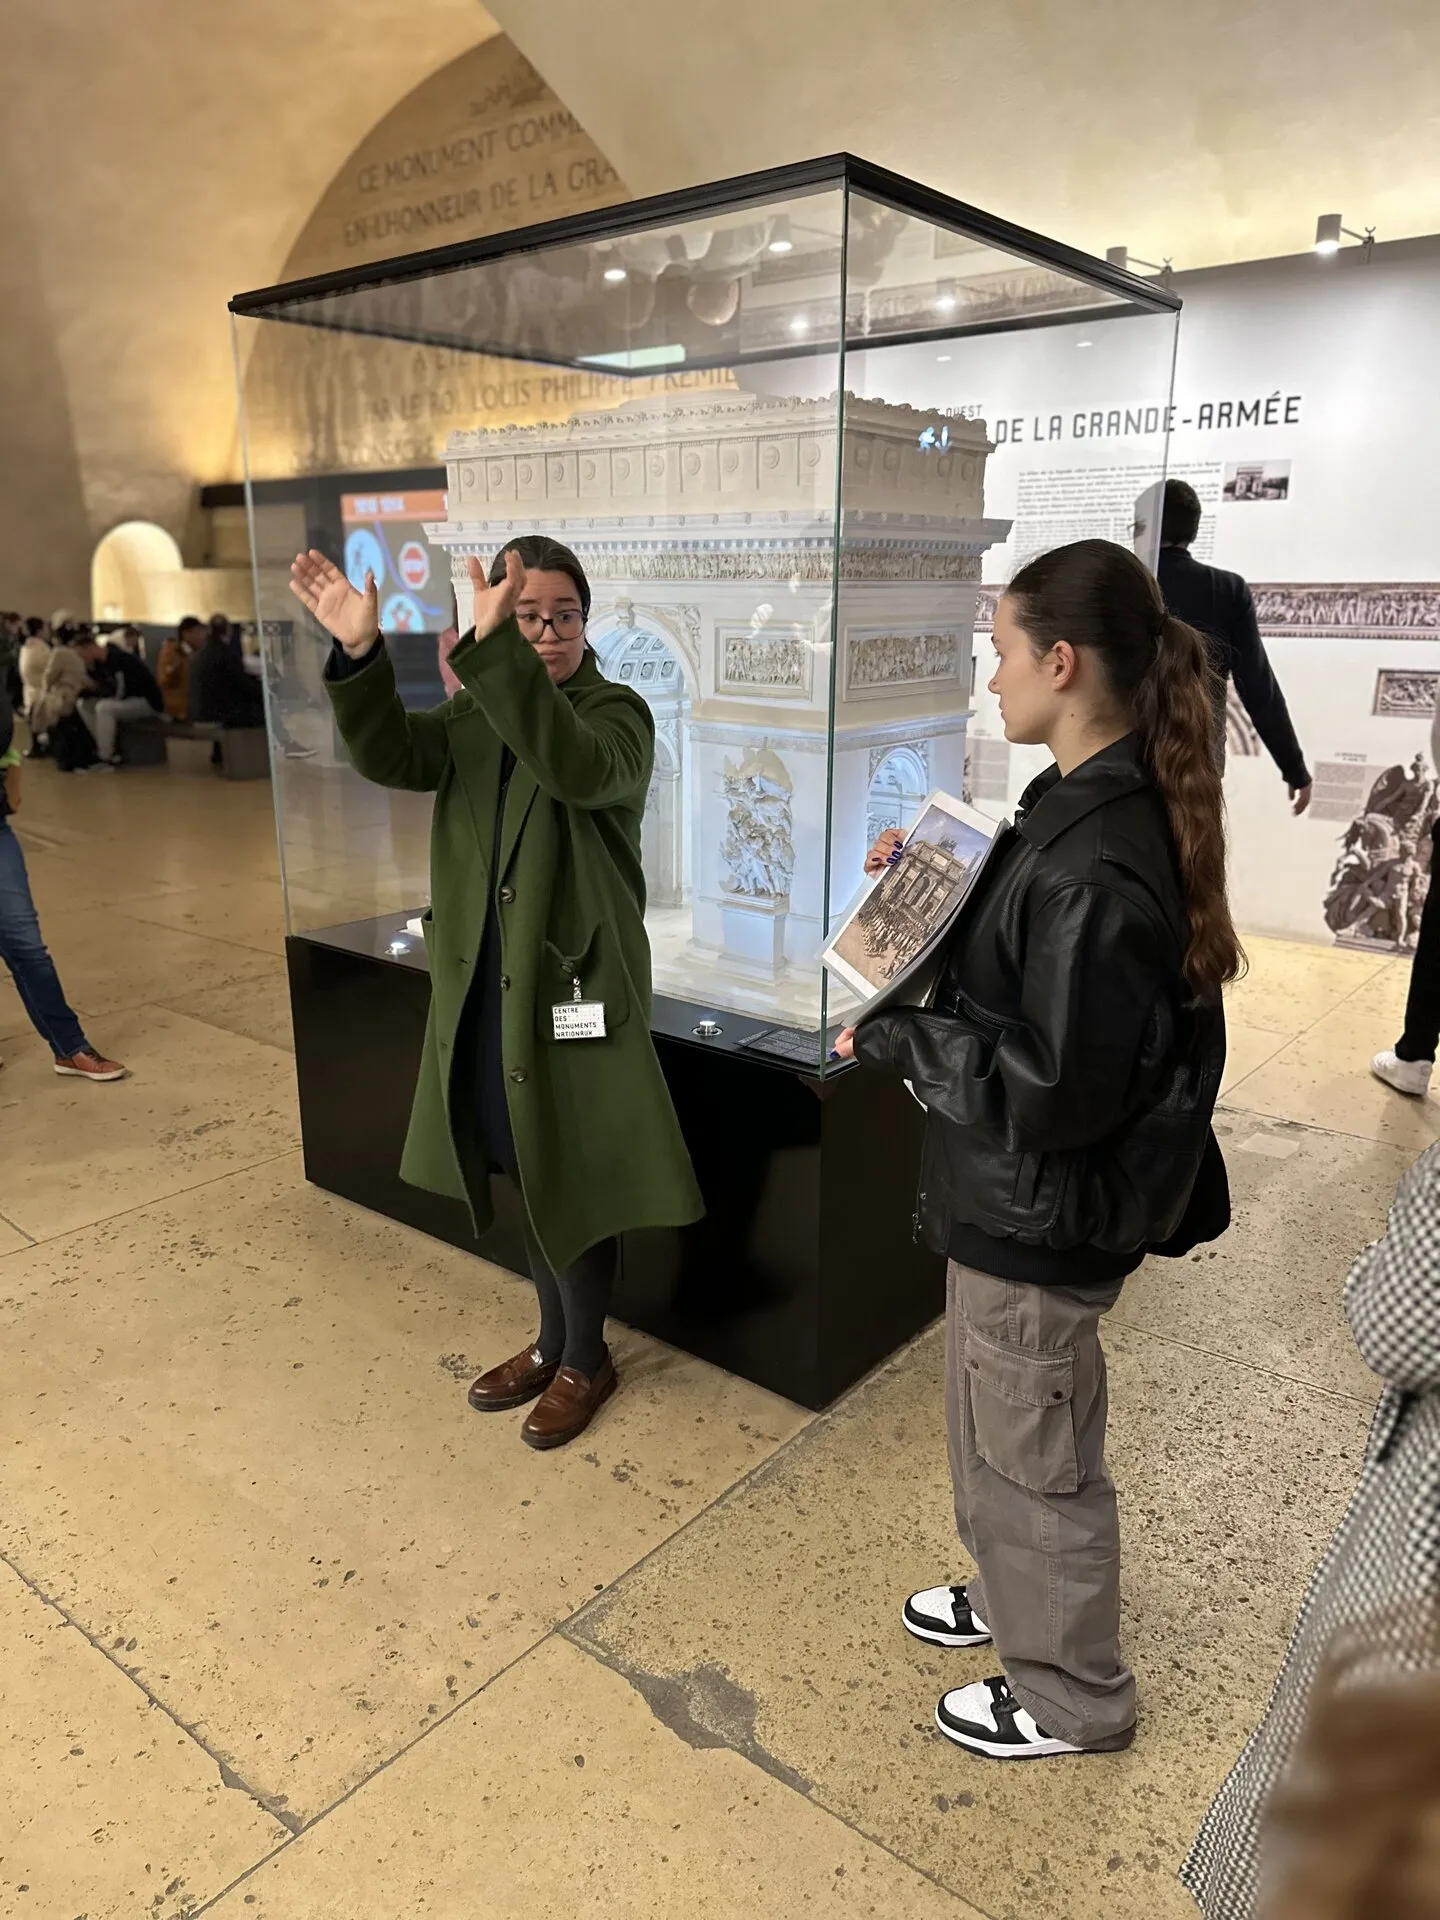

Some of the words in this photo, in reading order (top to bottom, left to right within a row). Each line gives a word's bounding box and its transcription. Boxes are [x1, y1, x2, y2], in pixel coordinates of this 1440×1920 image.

[357, 164, 381, 194] CE
[384, 130, 499, 187] MONUMENT
[490, 177, 519, 212] DE
[528, 170, 559, 202] LA
[472, 378, 530, 412] LOUIS
[541, 371, 633, 405] PHILIPPE
[945, 404, 984, 418] OUEST
[995, 418, 1024, 444] DE
[1033, 415, 1062, 442] LA
[554, 1007, 579, 1015] CENTRE
[555, 1022, 597, 1030] MONUMENTS
